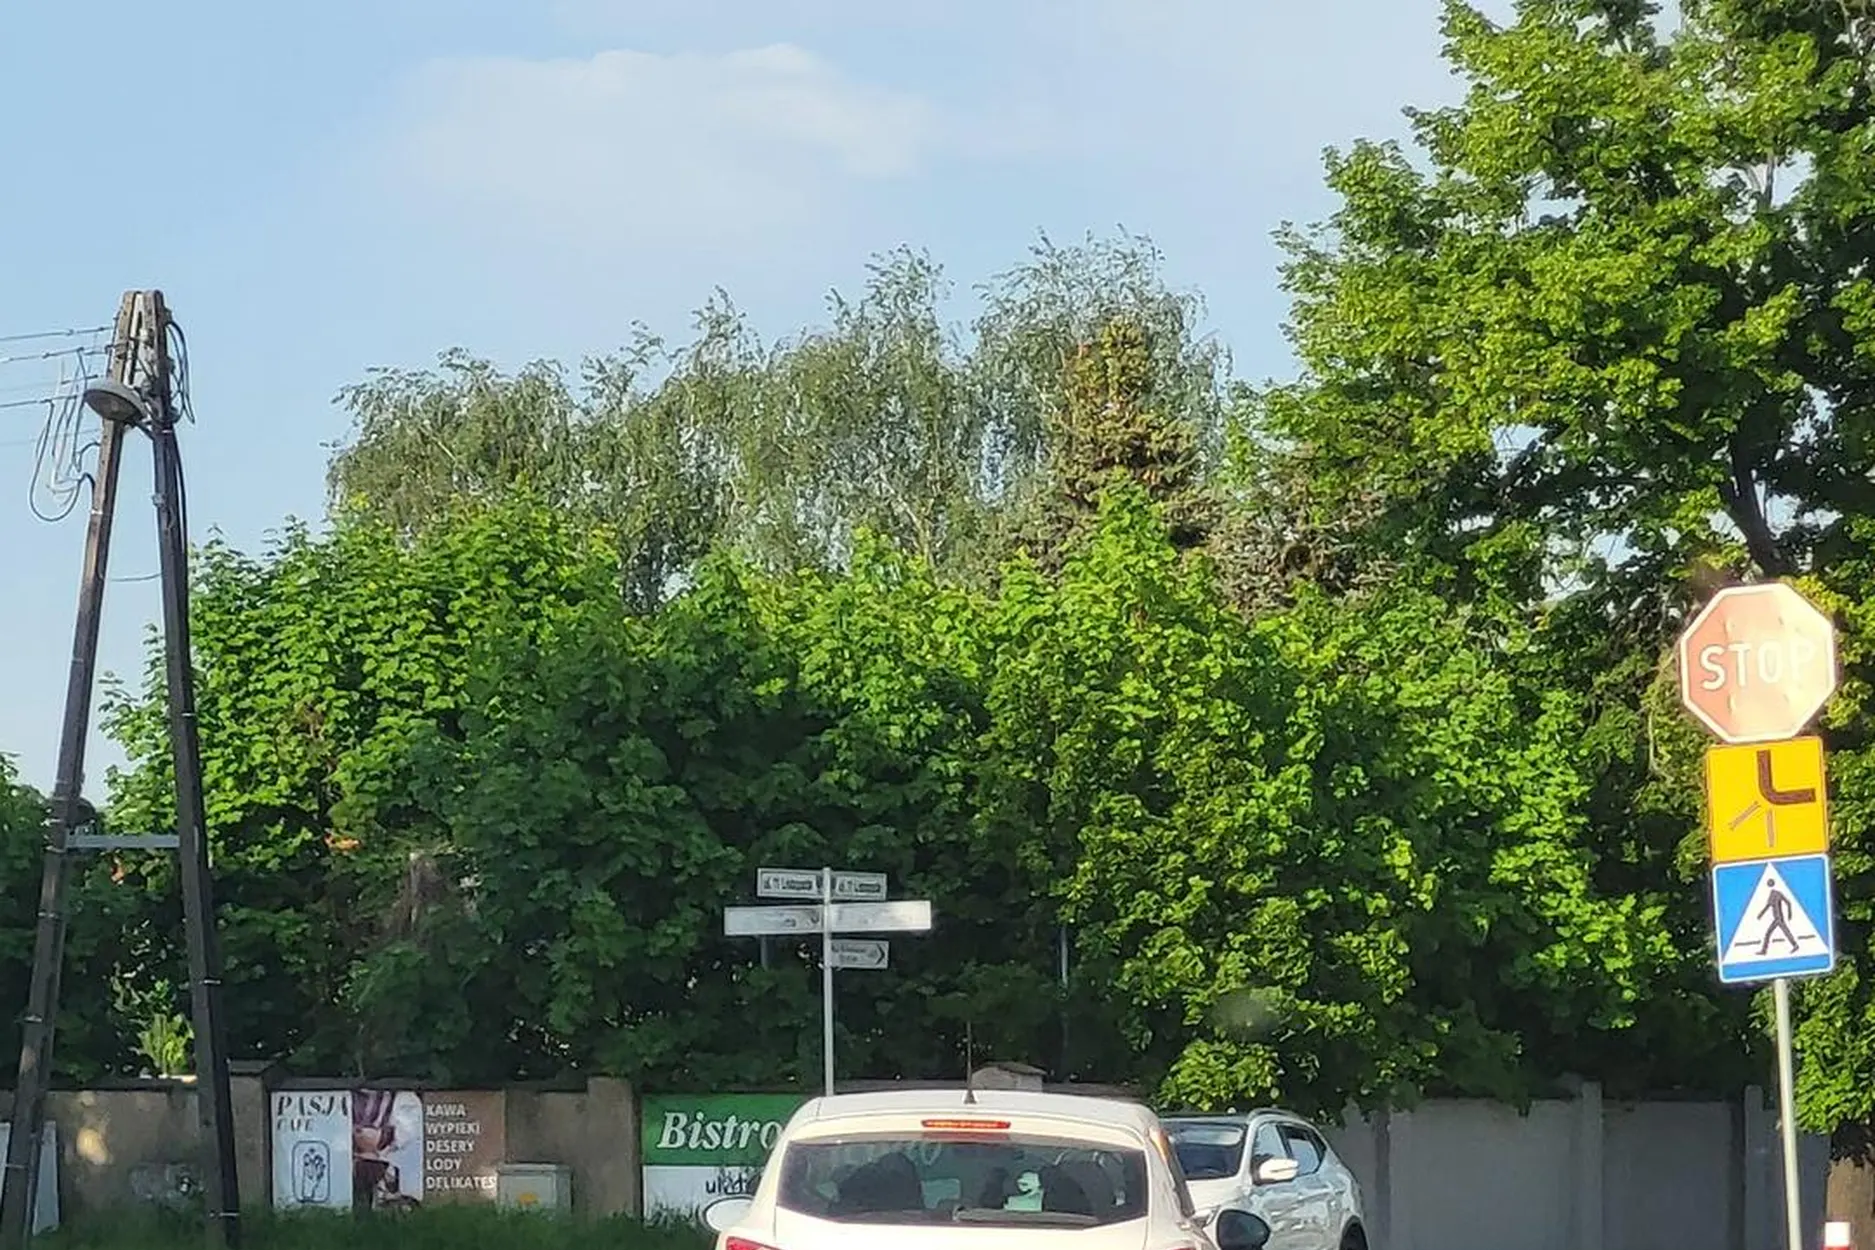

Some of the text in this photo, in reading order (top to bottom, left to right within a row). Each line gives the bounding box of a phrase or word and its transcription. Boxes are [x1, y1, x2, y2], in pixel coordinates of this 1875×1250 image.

[1699, 641, 1816, 691] STOP
[426, 1104, 466, 1117] KAWA
[425, 1122, 481, 1135] WYPIEKI
[657, 1111, 783, 1149] Bistro
[426, 1140, 474, 1153] DESERY
[426, 1158, 461, 1171] LODY
